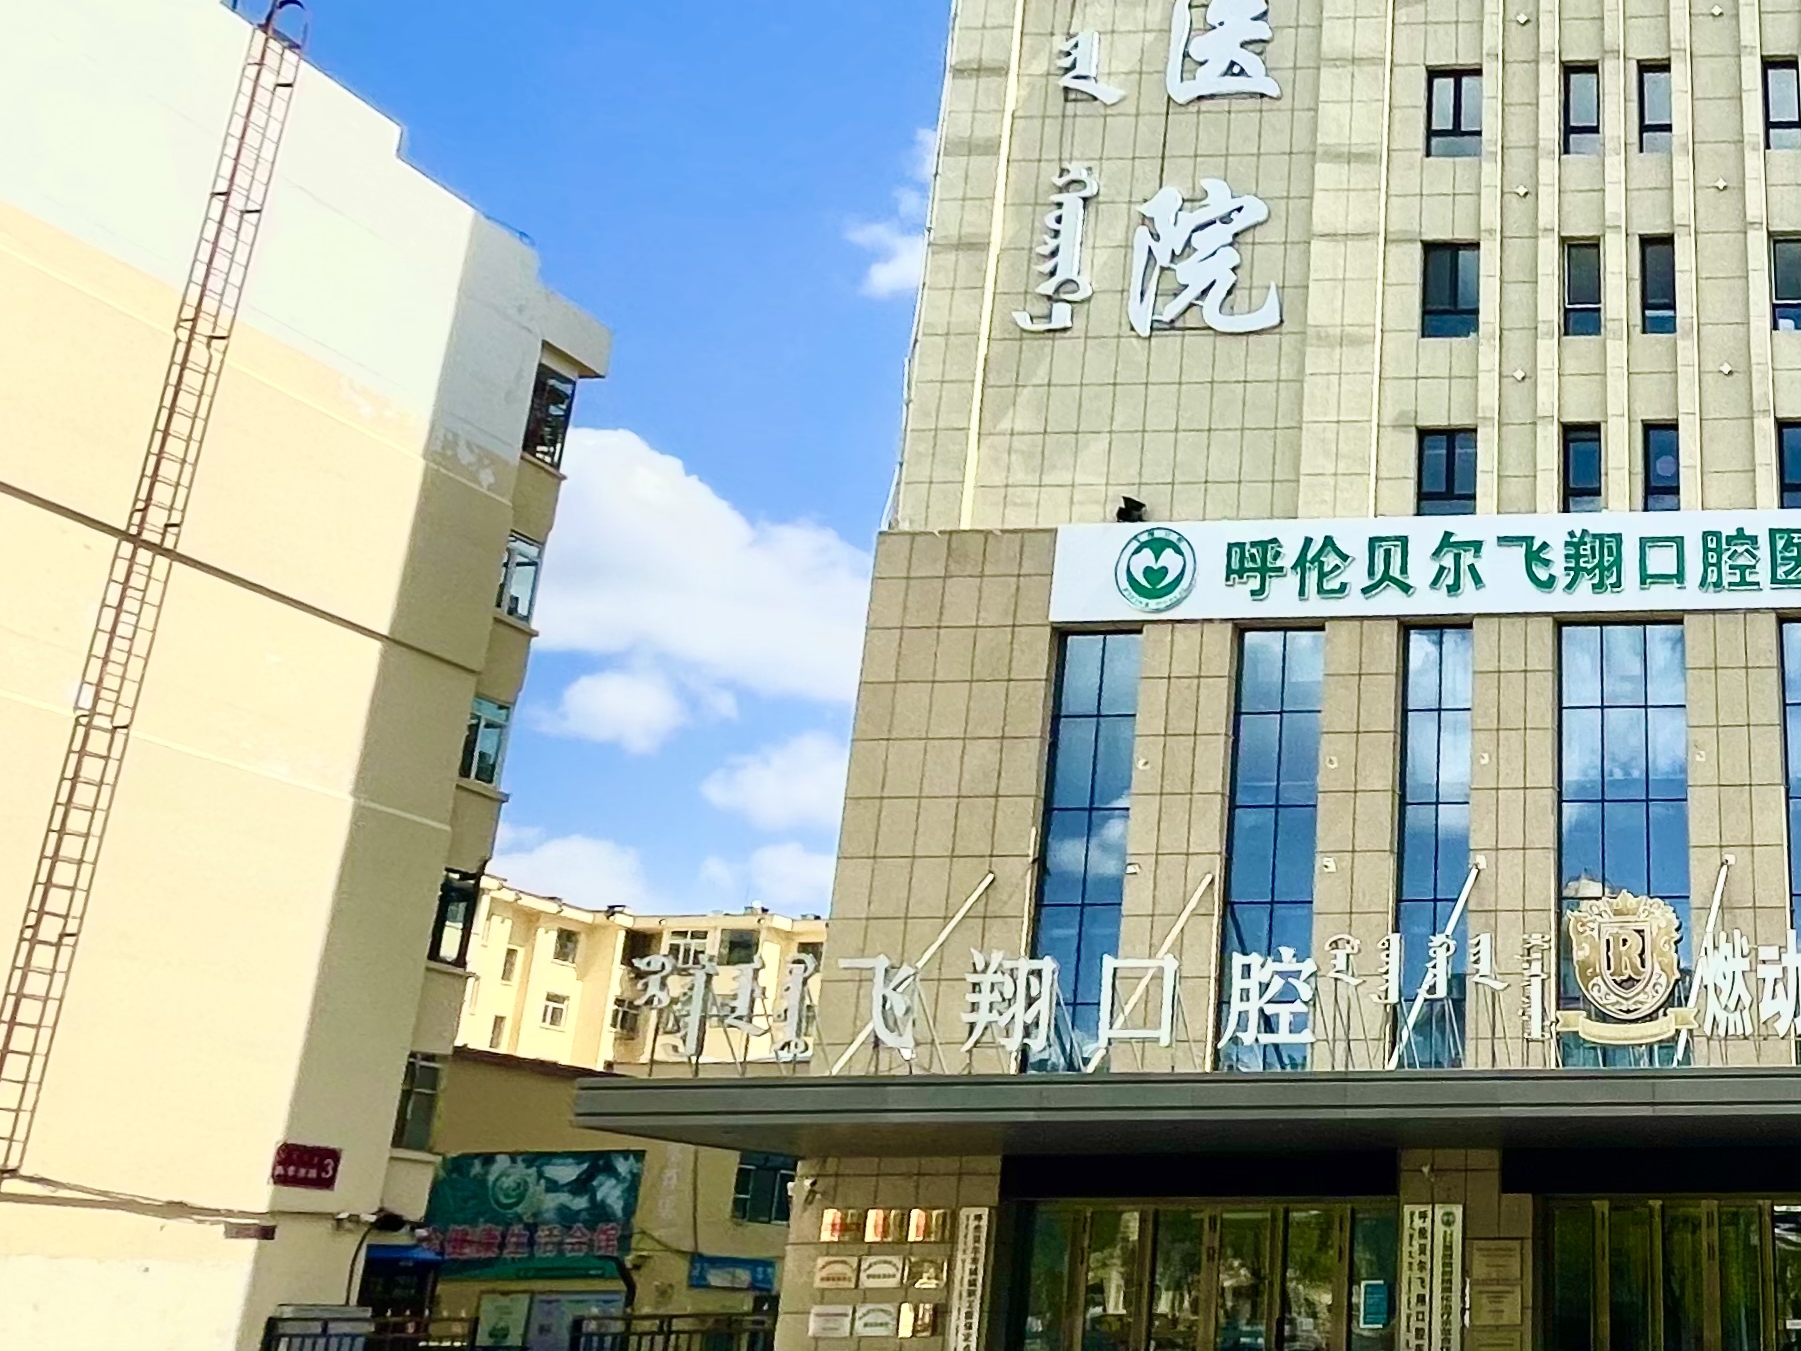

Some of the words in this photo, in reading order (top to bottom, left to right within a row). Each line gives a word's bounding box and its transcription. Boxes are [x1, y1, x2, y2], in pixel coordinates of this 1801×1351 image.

[1608, 928, 1647, 981] R
[837, 946, 1318, 1061] 飞翔口腔
[320, 1158, 335, 1179] 3
